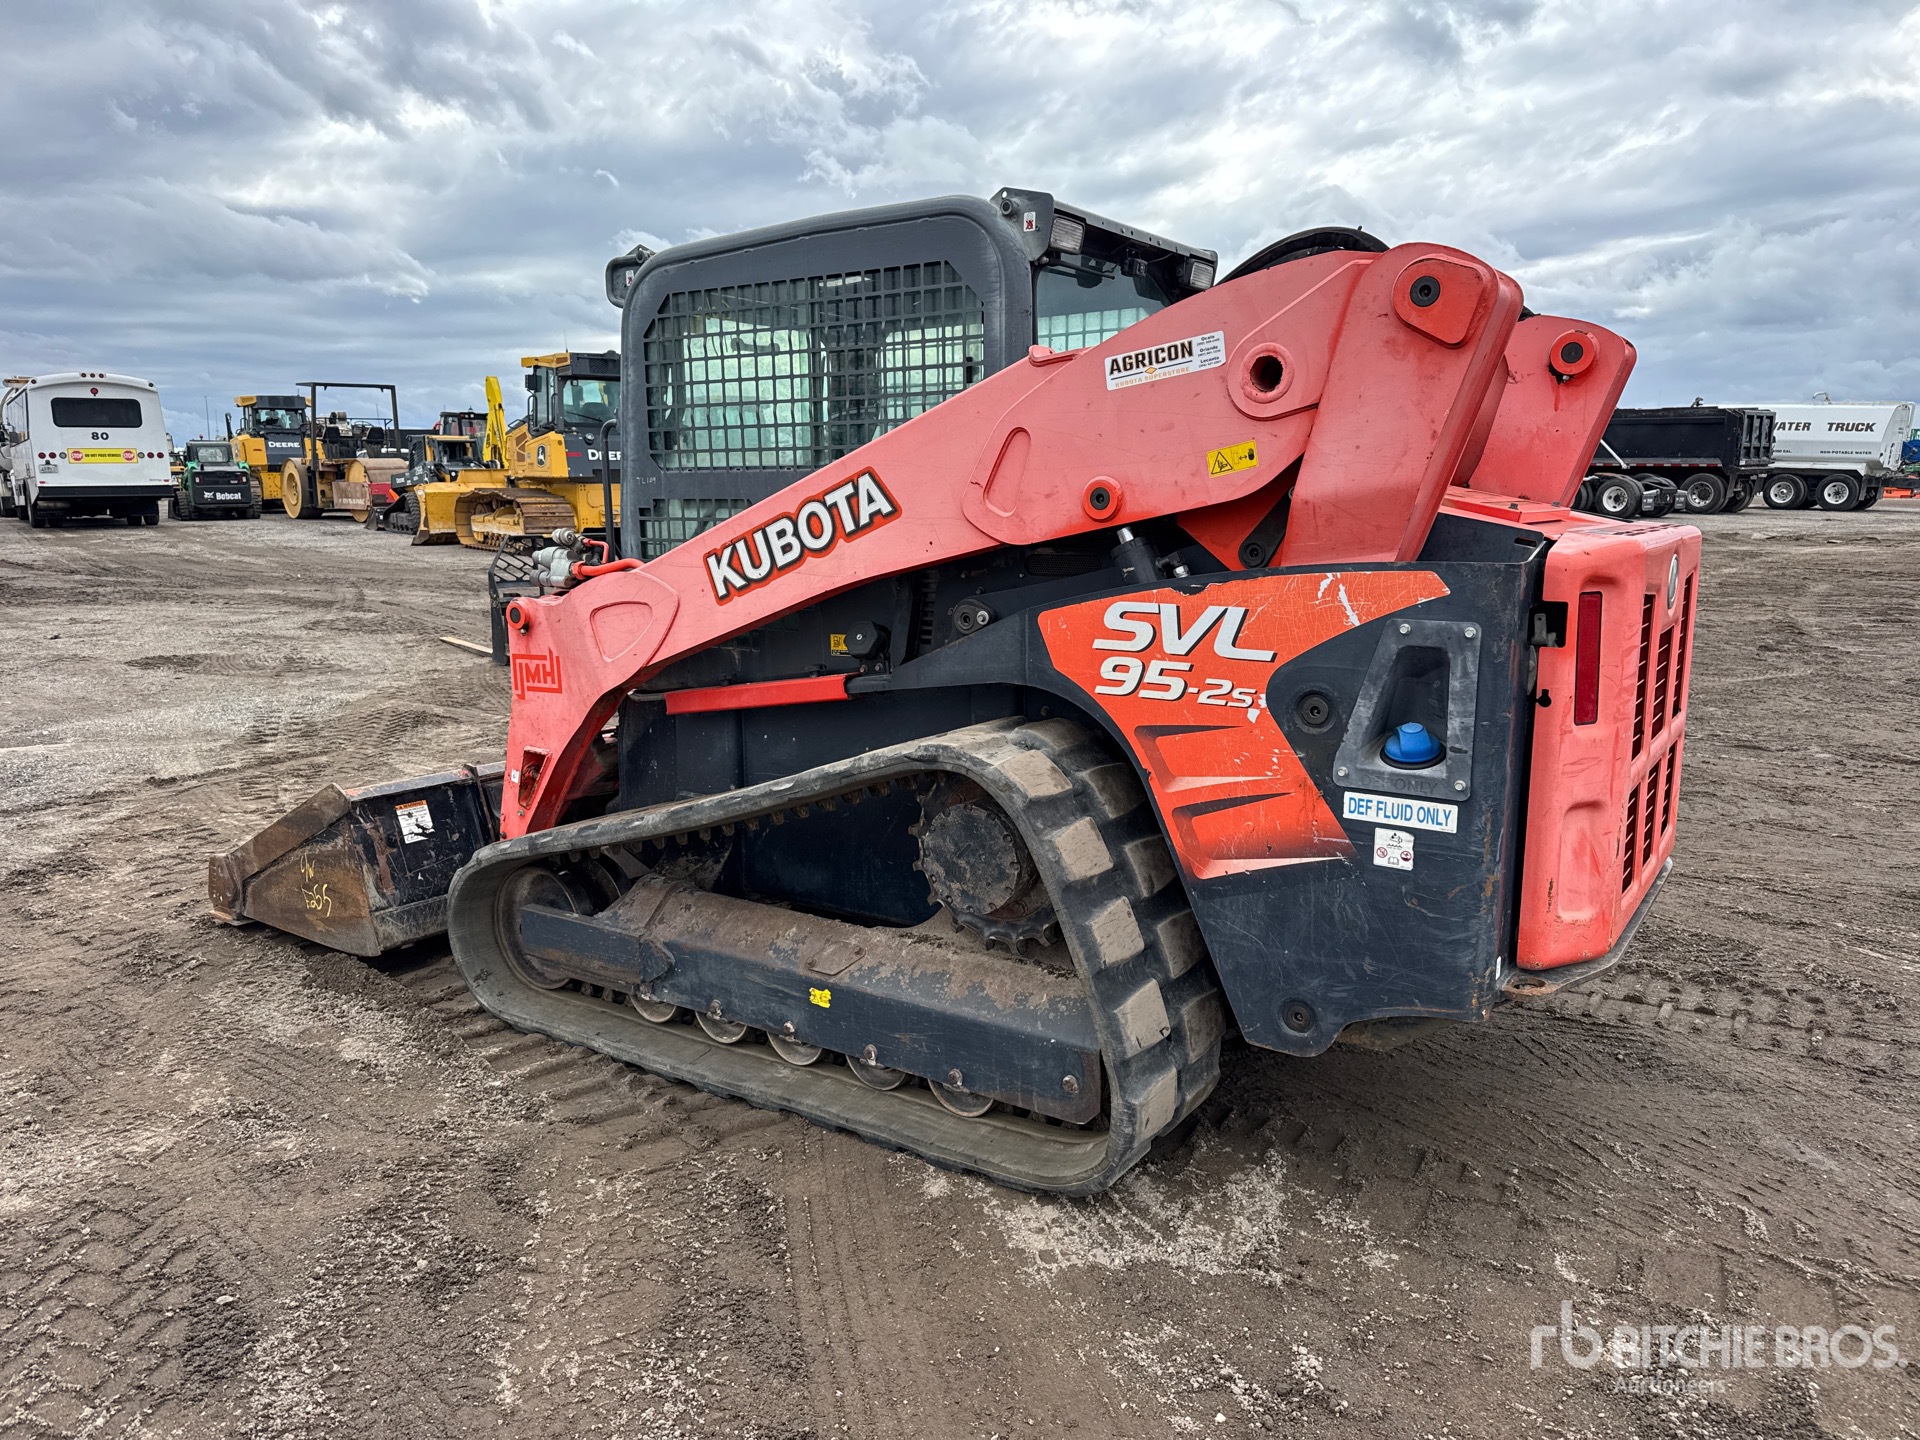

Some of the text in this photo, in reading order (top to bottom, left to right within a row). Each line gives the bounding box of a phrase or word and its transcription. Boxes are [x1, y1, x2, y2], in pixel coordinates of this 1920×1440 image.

[1109, 340, 1193, 376] AGRICON
[1115, 366, 1190, 388] KUBOTA SUPERSTORE
[91, 431, 109, 440] 80
[1827, 422, 1877, 432] TRUCK
[215, 492, 242, 500] Bobcat
[706, 472, 896, 599] KUBOTA
[1092, 601, 1278, 662] SVL
[1394, 778, 1438, 794] ONLY
[1348, 796, 1452, 827] DEF FLUID ONLY
